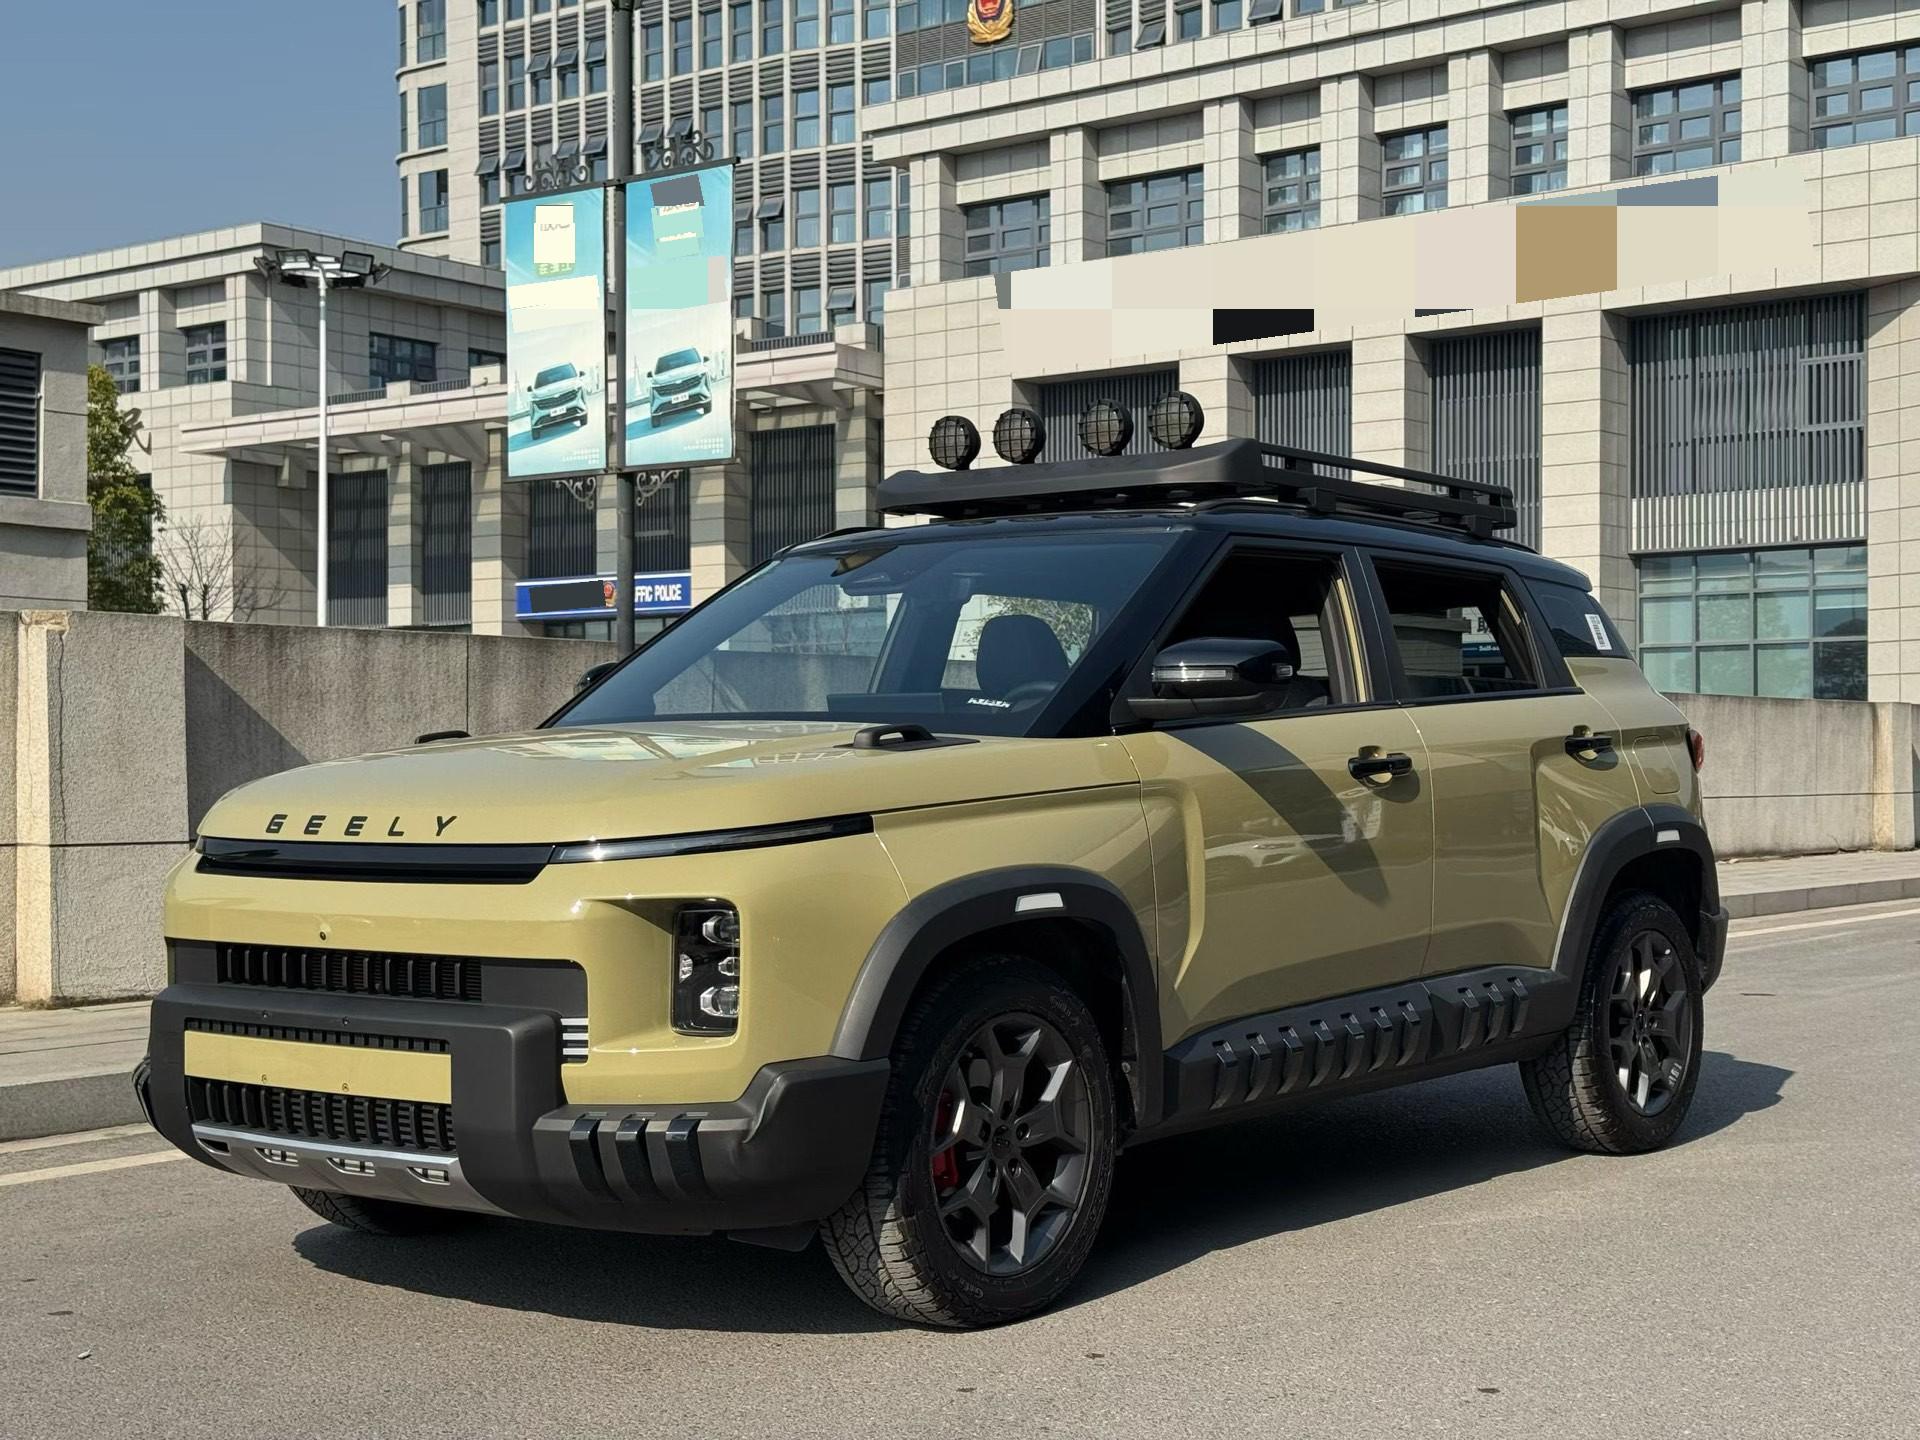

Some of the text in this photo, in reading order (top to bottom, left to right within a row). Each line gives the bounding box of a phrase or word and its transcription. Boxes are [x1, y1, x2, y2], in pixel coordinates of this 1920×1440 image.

[634, 583, 682, 603] FFIC POLICE
[265, 813, 458, 837] GEELY
